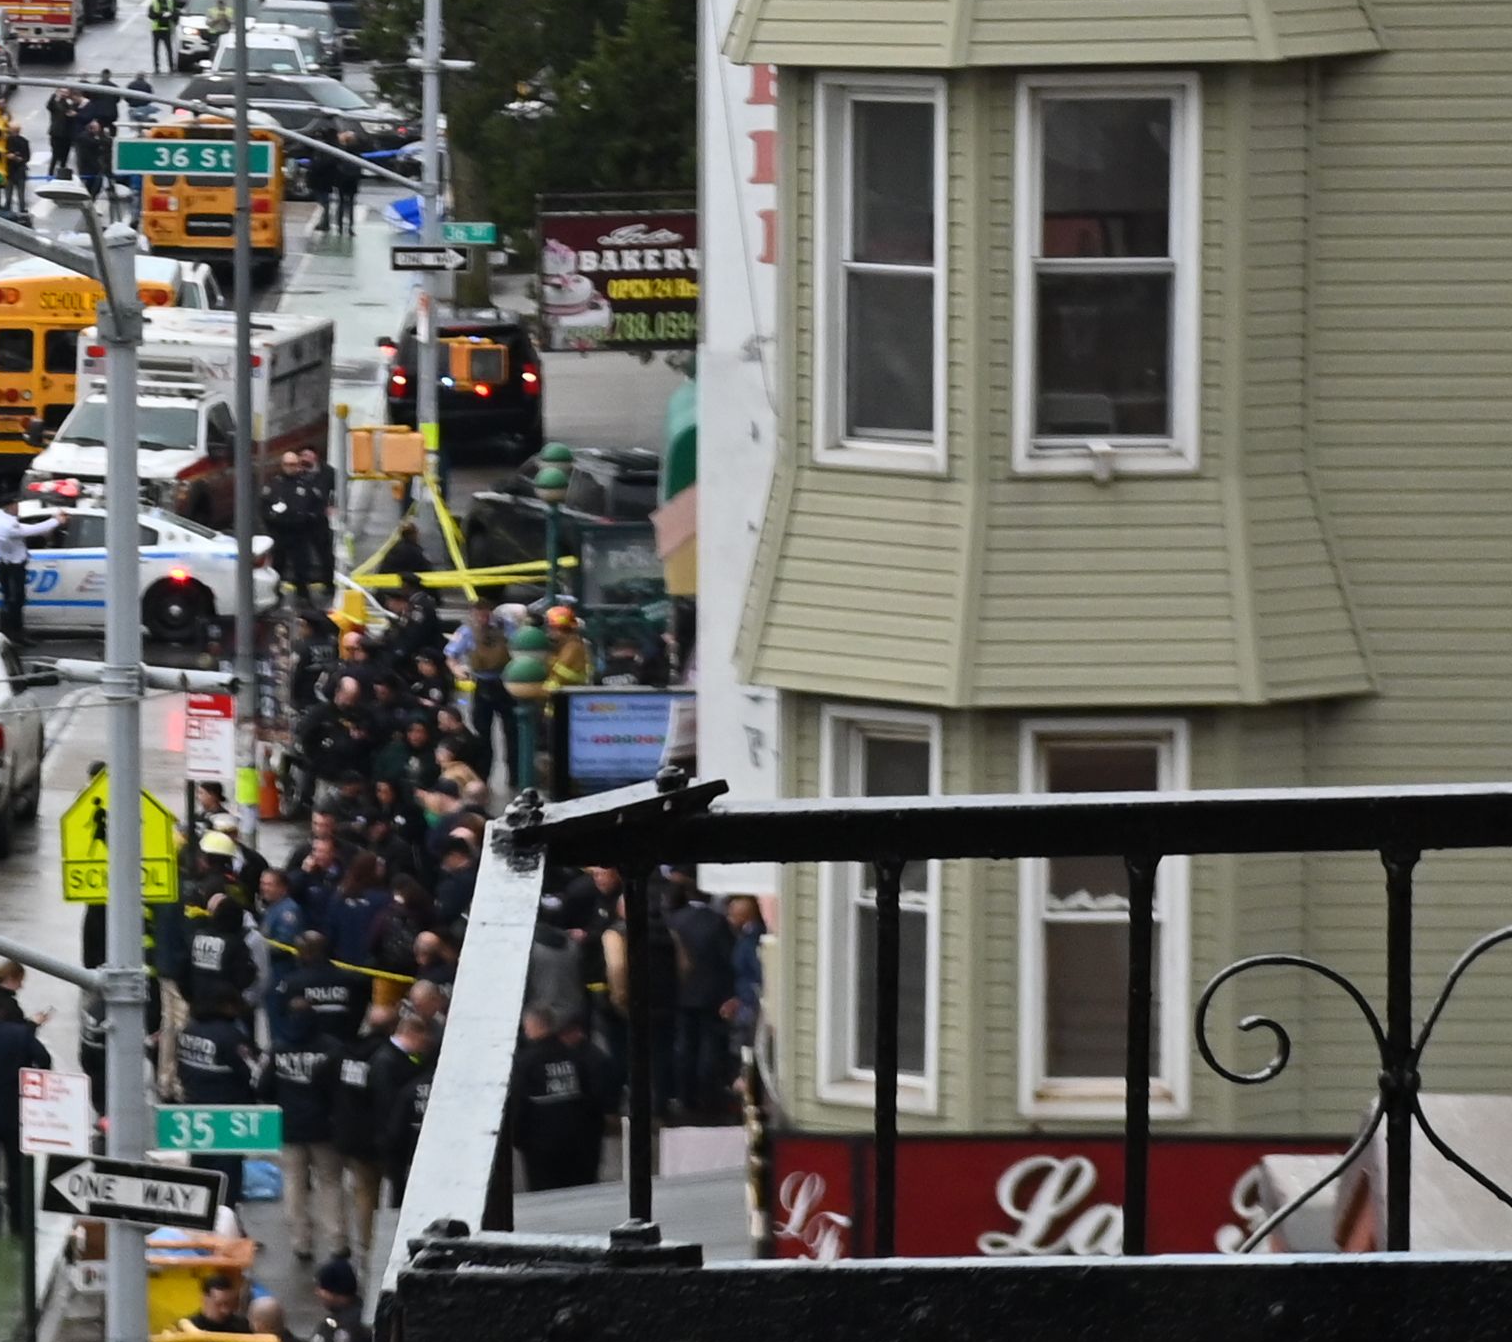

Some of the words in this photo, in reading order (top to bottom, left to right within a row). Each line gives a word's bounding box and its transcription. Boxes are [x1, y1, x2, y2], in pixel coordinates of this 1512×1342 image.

[152, 147, 190, 167] 36
[199, 148, 233, 169] St
[578, 249, 702, 273] BAKERY
[40, 292, 87, 309] SCHOOL
[169, 1111, 216, 1149] 35
[229, 1112, 262, 1139] ST
[66, 1172, 116, 1202] ONE
[142, 1180, 200, 1213] WAY
